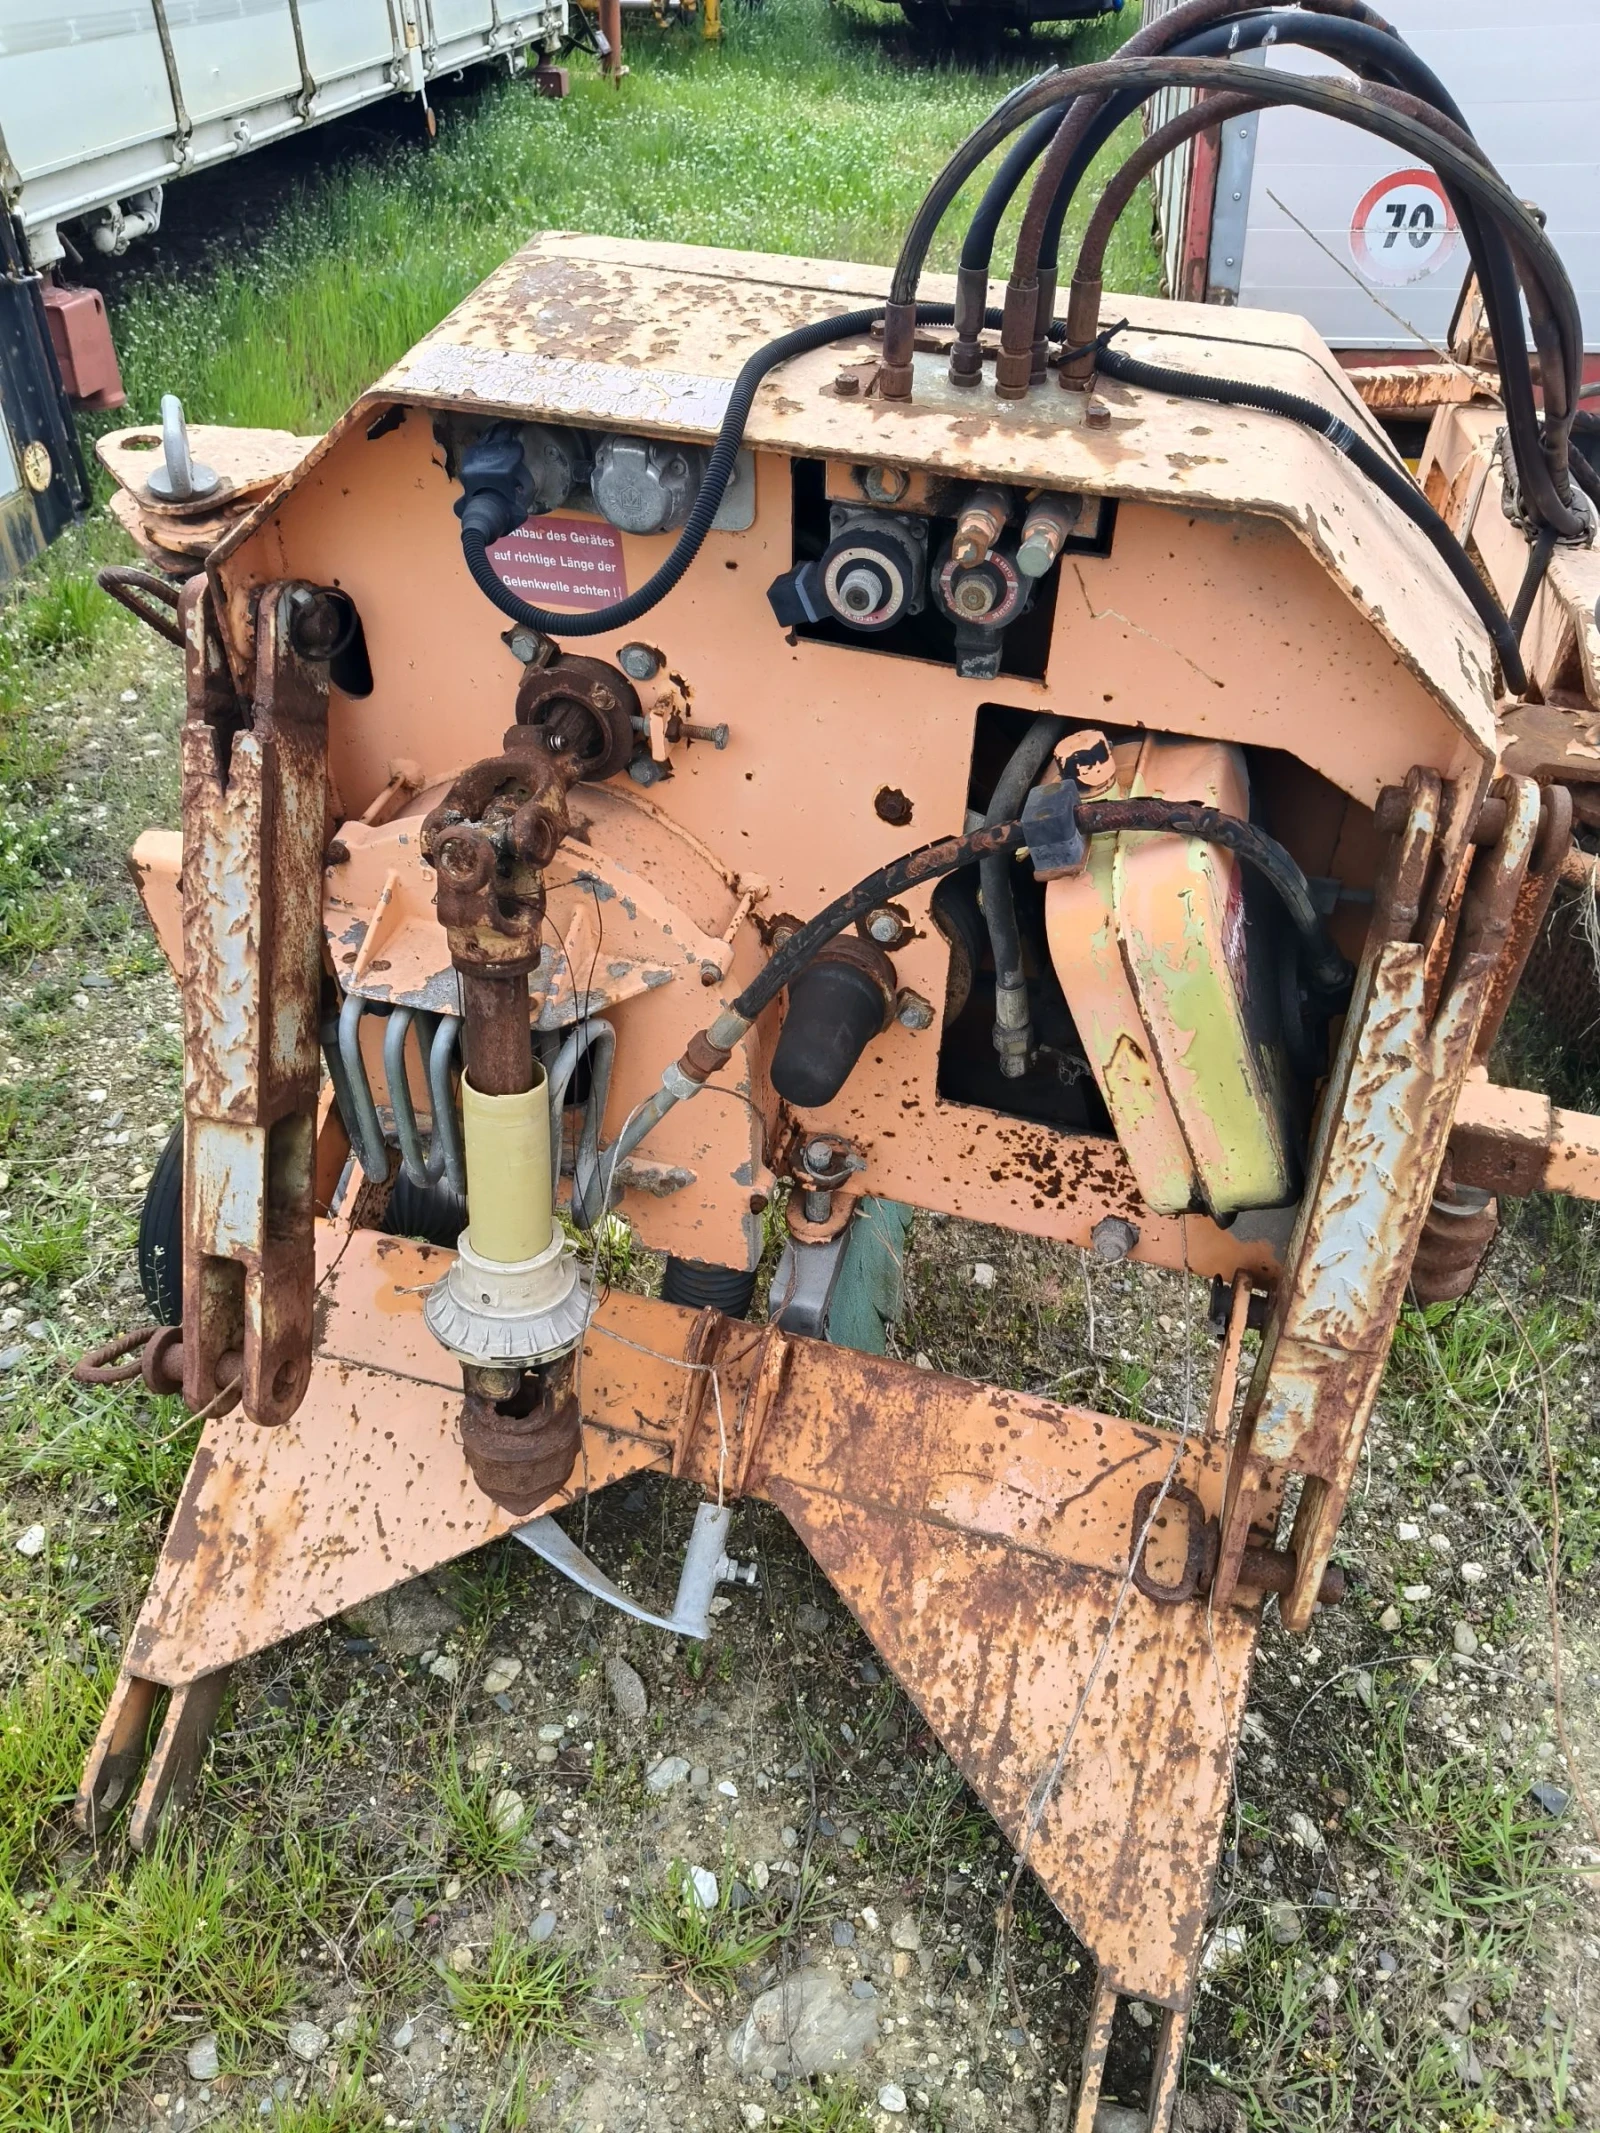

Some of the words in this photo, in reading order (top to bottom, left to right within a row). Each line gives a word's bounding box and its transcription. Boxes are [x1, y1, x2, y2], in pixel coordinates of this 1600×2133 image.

[1383, 203, 1434, 249] 70
[546, 530, 567, 541] des
[570, 532, 615, 547] Gerätes
[494, 550, 511, 561] auf
[514, 551, 557, 567] richtige
[560, 556, 595, 571] Länge
[597, 560, 616, 572] der
[502, 575, 570, 593] Gelenkwelle
[573, 584, 611, 598] achten
